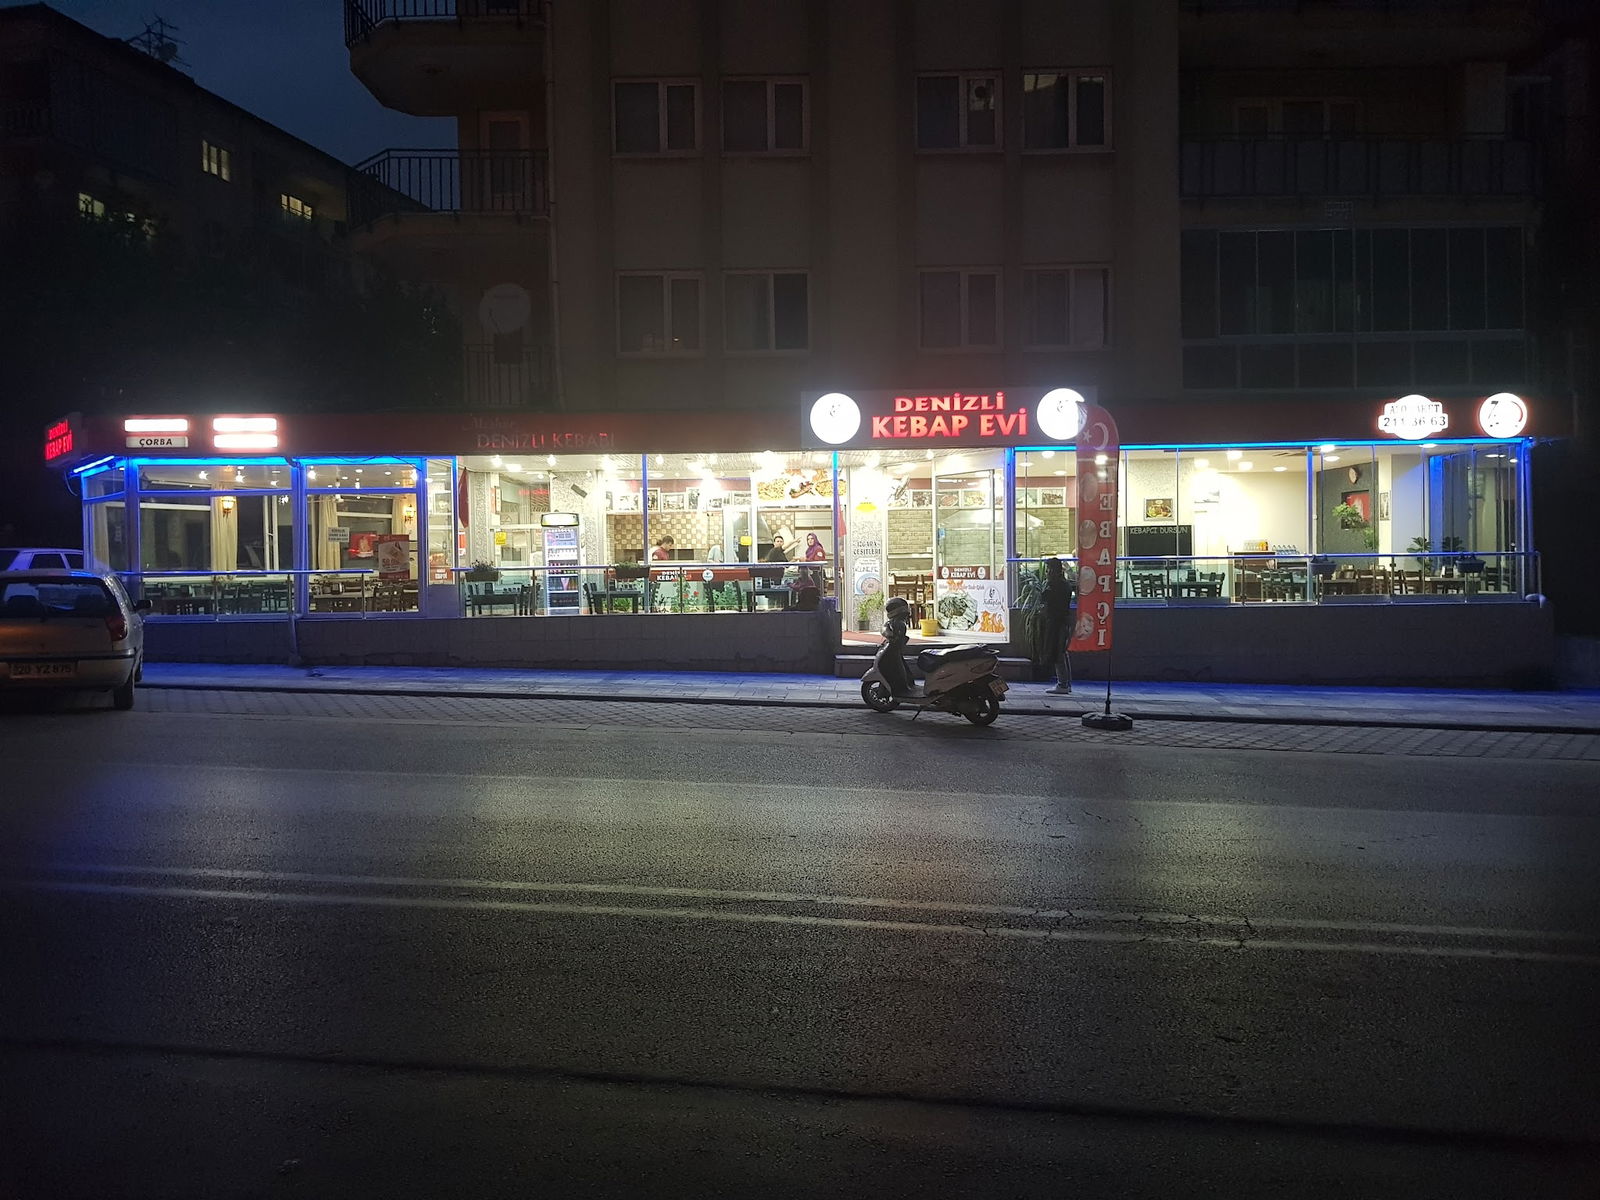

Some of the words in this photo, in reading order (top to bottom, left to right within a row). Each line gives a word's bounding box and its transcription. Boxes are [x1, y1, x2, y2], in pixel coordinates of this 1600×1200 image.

[895, 392, 1003, 413] DENİZLİ
[872, 415, 968, 438] KEBAP
[979, 408, 1027, 436] EVİ
[139, 438, 173, 449] ÇORBA
[1159, 526, 1188, 534] DURSUN
